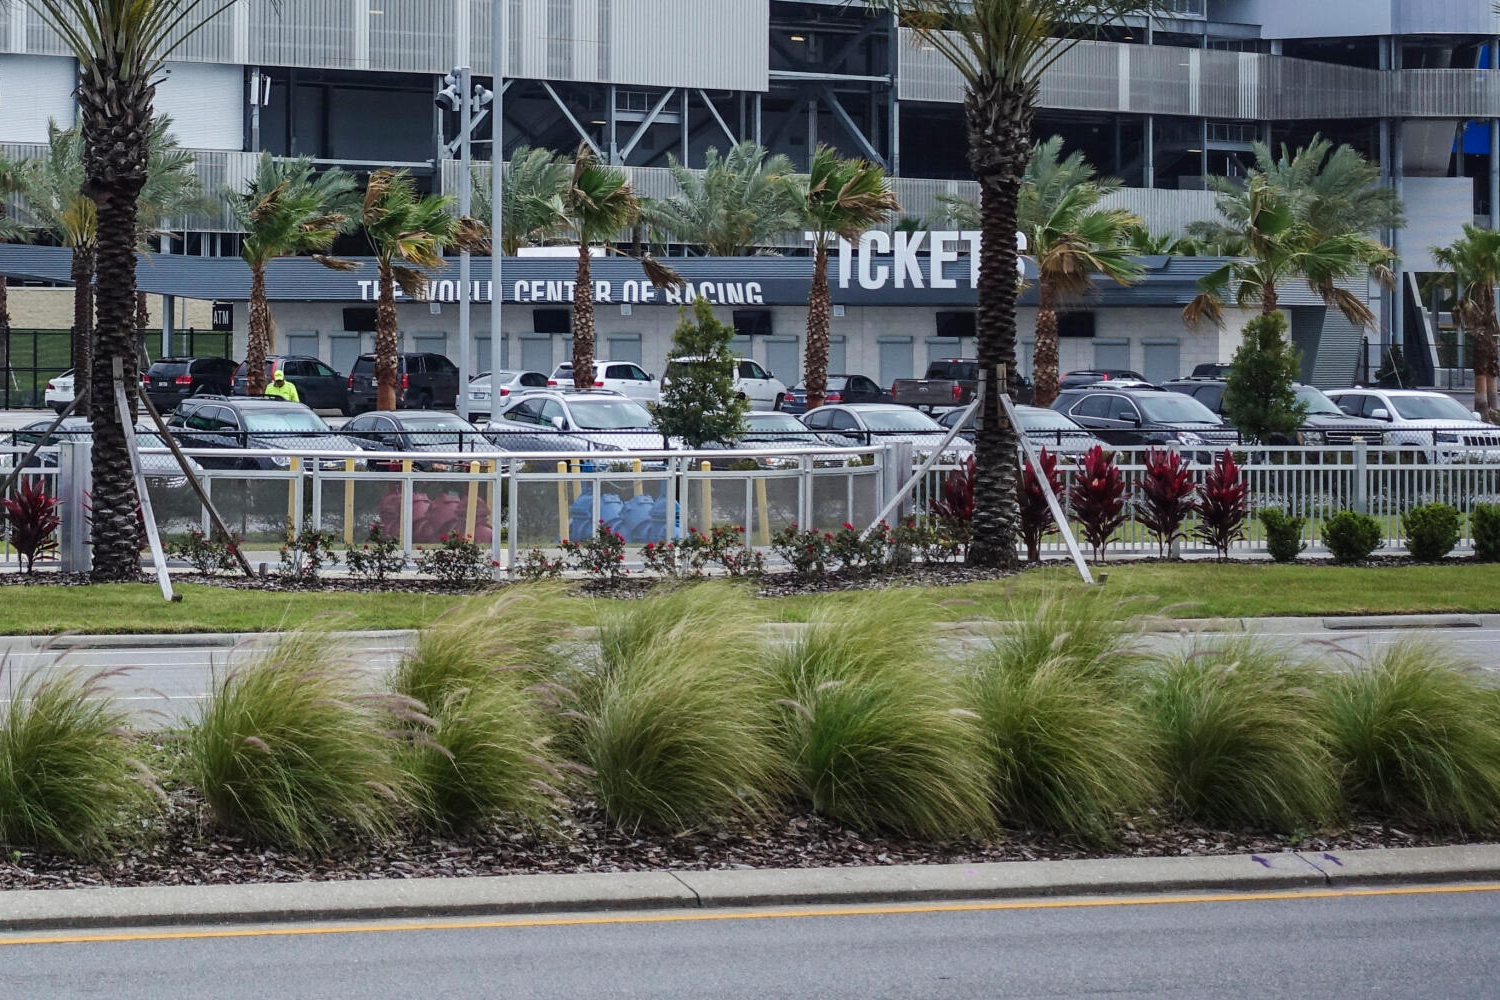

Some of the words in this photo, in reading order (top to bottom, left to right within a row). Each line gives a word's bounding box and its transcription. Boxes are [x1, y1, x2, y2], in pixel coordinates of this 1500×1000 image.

[804, 230, 1029, 290] TICKET
[416, 280, 503, 301] WOL
[514, 280, 612, 303] CENTR
[623, 280, 655, 302] OF
[664, 281, 764, 305] RACING
[213, 310, 229, 325] ATM
